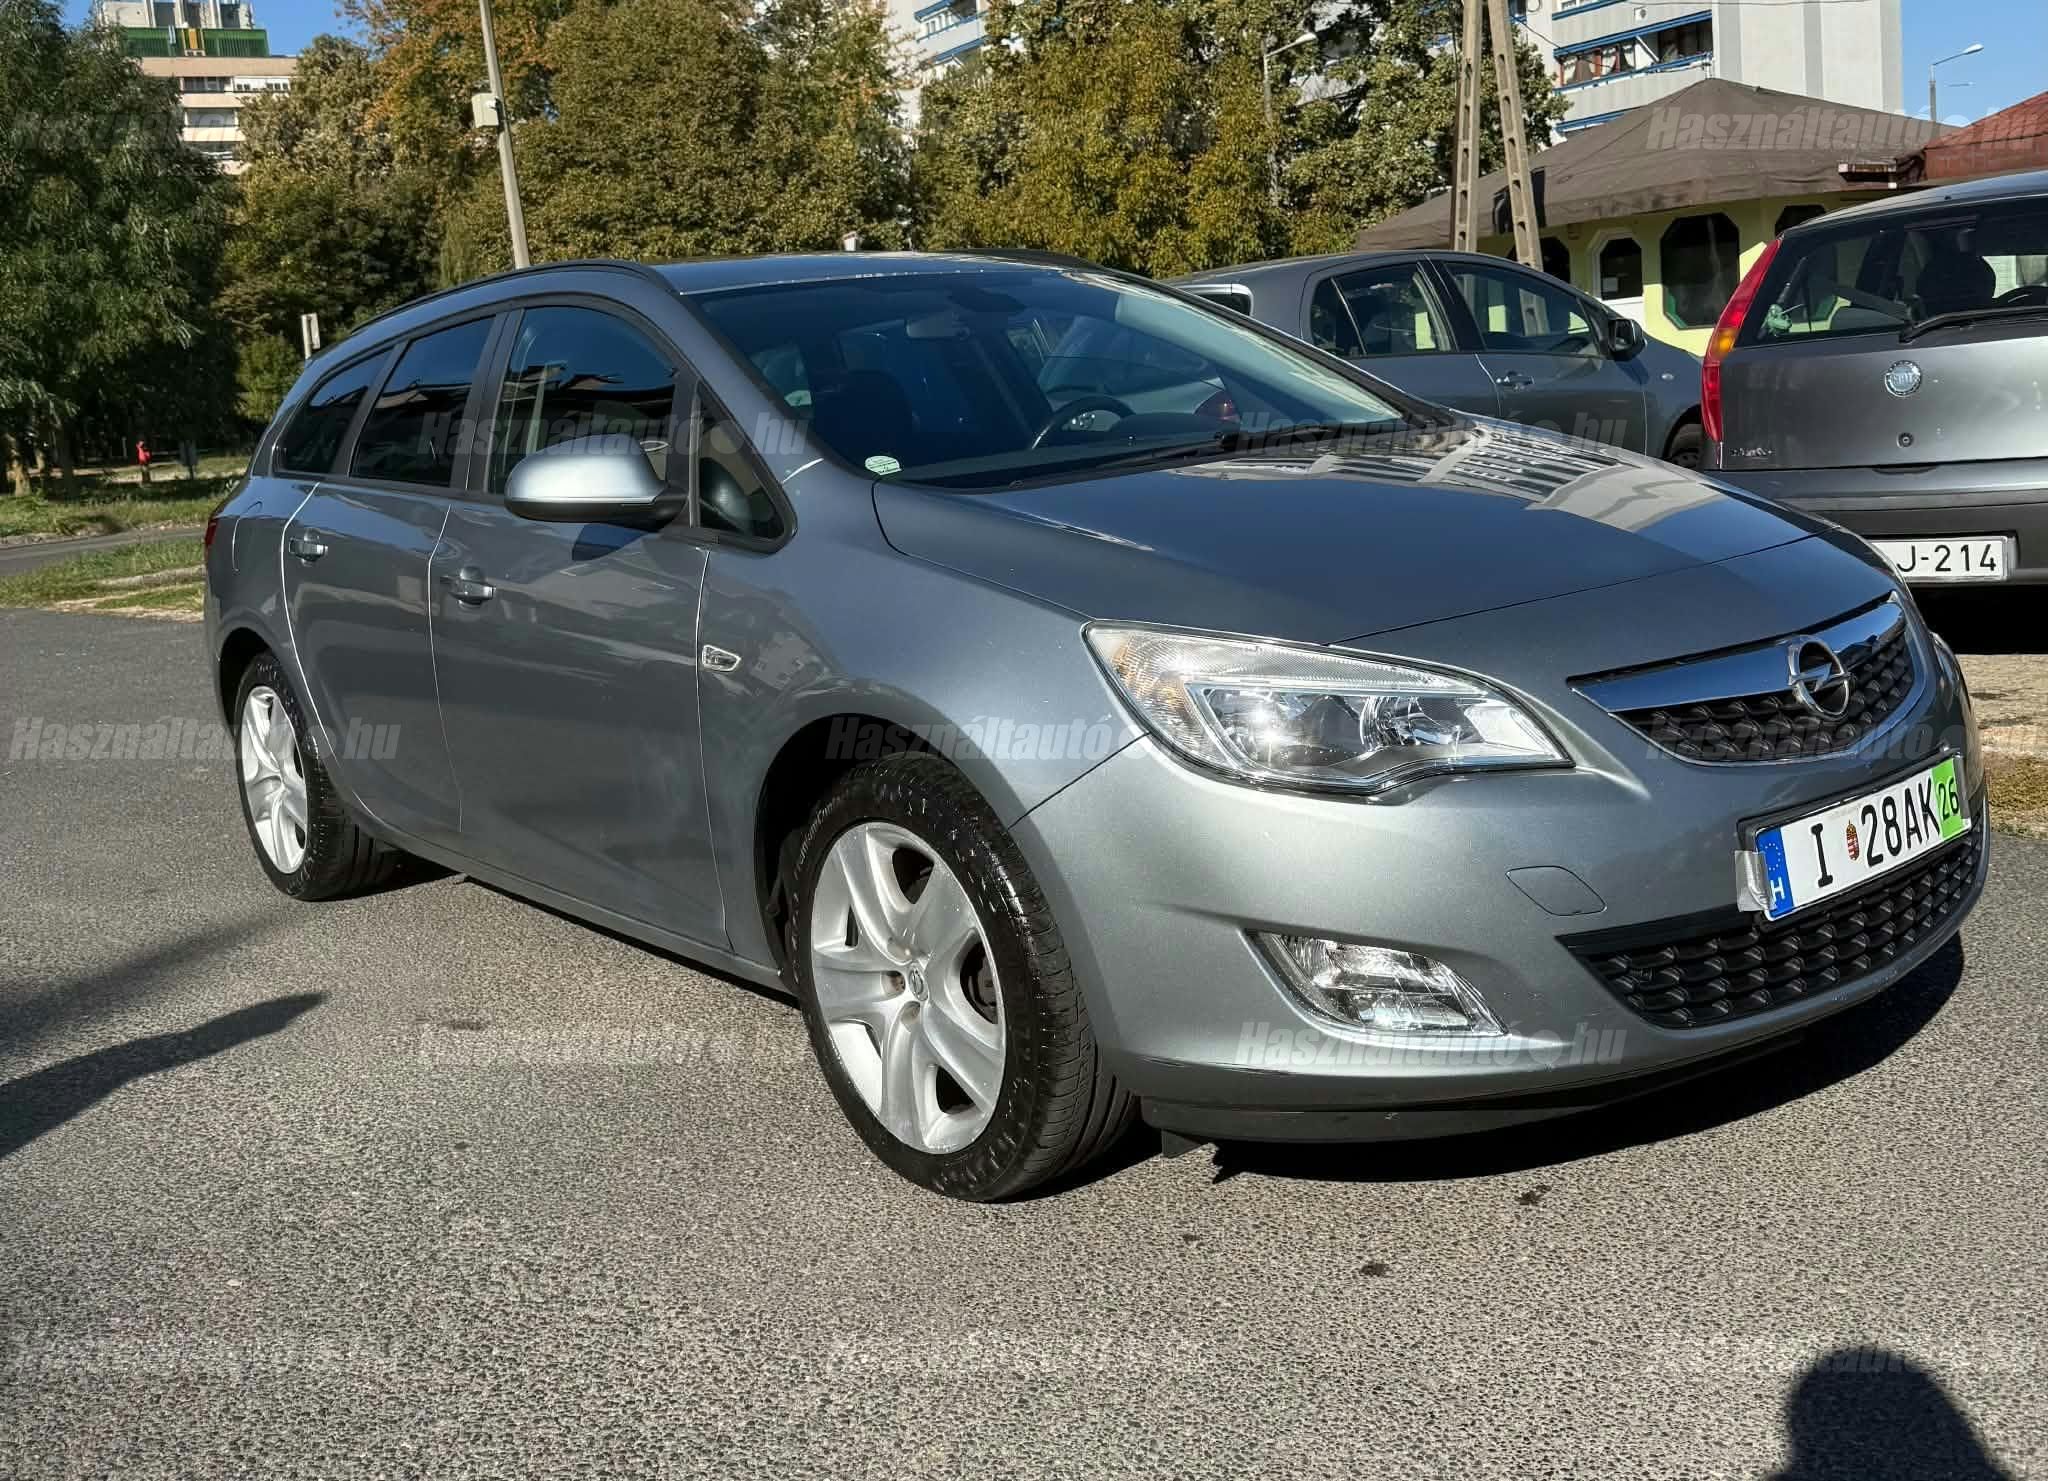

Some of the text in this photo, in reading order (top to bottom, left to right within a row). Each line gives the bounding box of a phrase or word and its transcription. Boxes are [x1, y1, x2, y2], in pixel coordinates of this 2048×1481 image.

[1811, 777, 1960, 888] I 28AK 26
[1770, 876, 1786, 902] H
